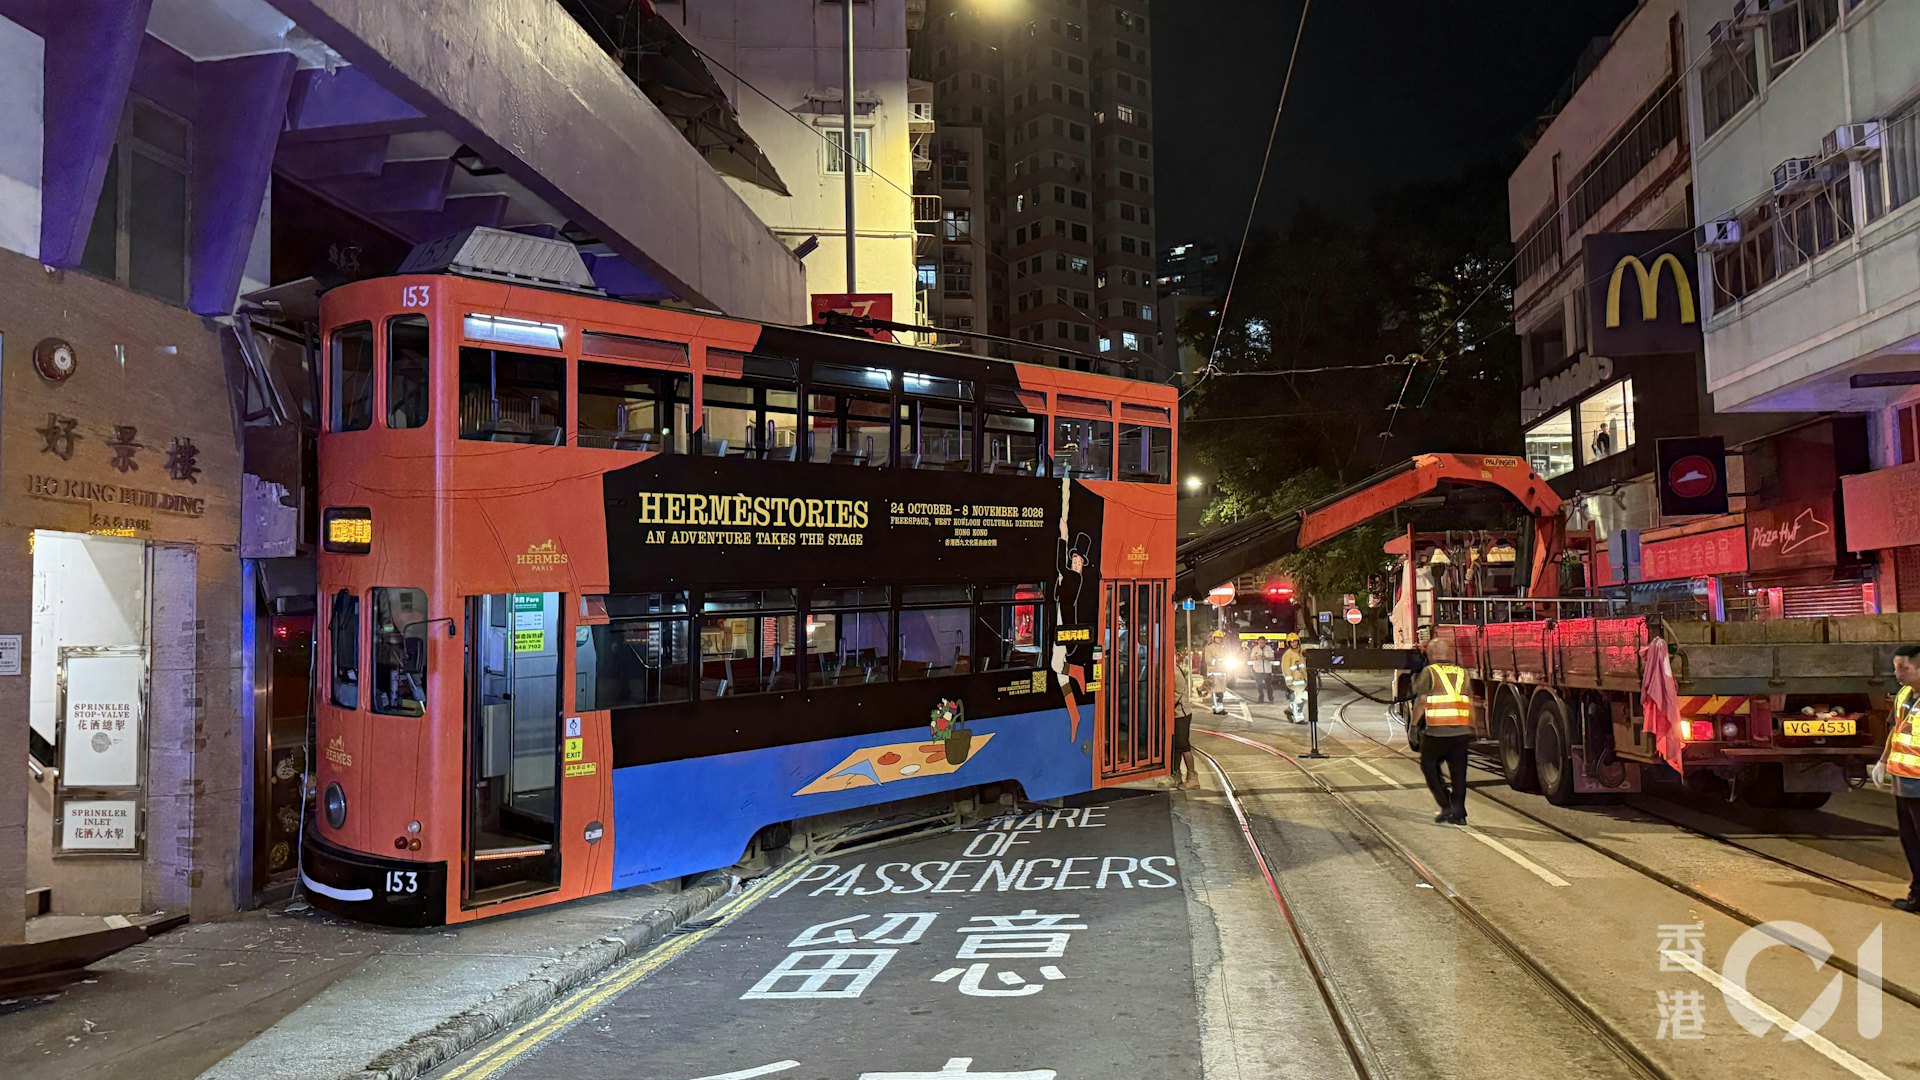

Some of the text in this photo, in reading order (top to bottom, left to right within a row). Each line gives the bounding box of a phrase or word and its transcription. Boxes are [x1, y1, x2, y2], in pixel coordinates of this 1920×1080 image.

[402, 285, 430, 307] 153
[37, 412, 201, 484] 好景樓
[1485, 458, 1516, 466] PALFINGER
[26, 474, 205, 515] HO KING BUILDING
[638, 492, 869, 528] HERMÈSTORIES
[890, 502, 905, 514] 24
[907, 503, 953, 515] OCTOBER
[972, 505, 1019, 517] NOVEMBER
[1021, 507, 1044, 518] 2026
[890, 516, 1044, 528] FREESPACE, WEST KOWLOON CULTURAL DISTRICT
[645, 531, 863, 546] AN ADVENTURE TAKES THE STAGE
[954, 528, 988, 537] HONG KONG
[1751, 521, 1802, 550] Pizza Hut
[525, 596, 540, 604] Fare
[73, 703, 130, 711] SPRINKLER
[1790, 722, 1851, 734] VG 4531
[566, 751, 581, 759] EXIT
[72, 809, 127, 817] SPRINKLER
[84, 818, 112, 826] INLET
[962, 829, 1042, 858] OF
[386, 871, 418, 893] 153
[769, 855, 1179, 899] PASSENGERS
[739, 909, 1088, 999] 留意
